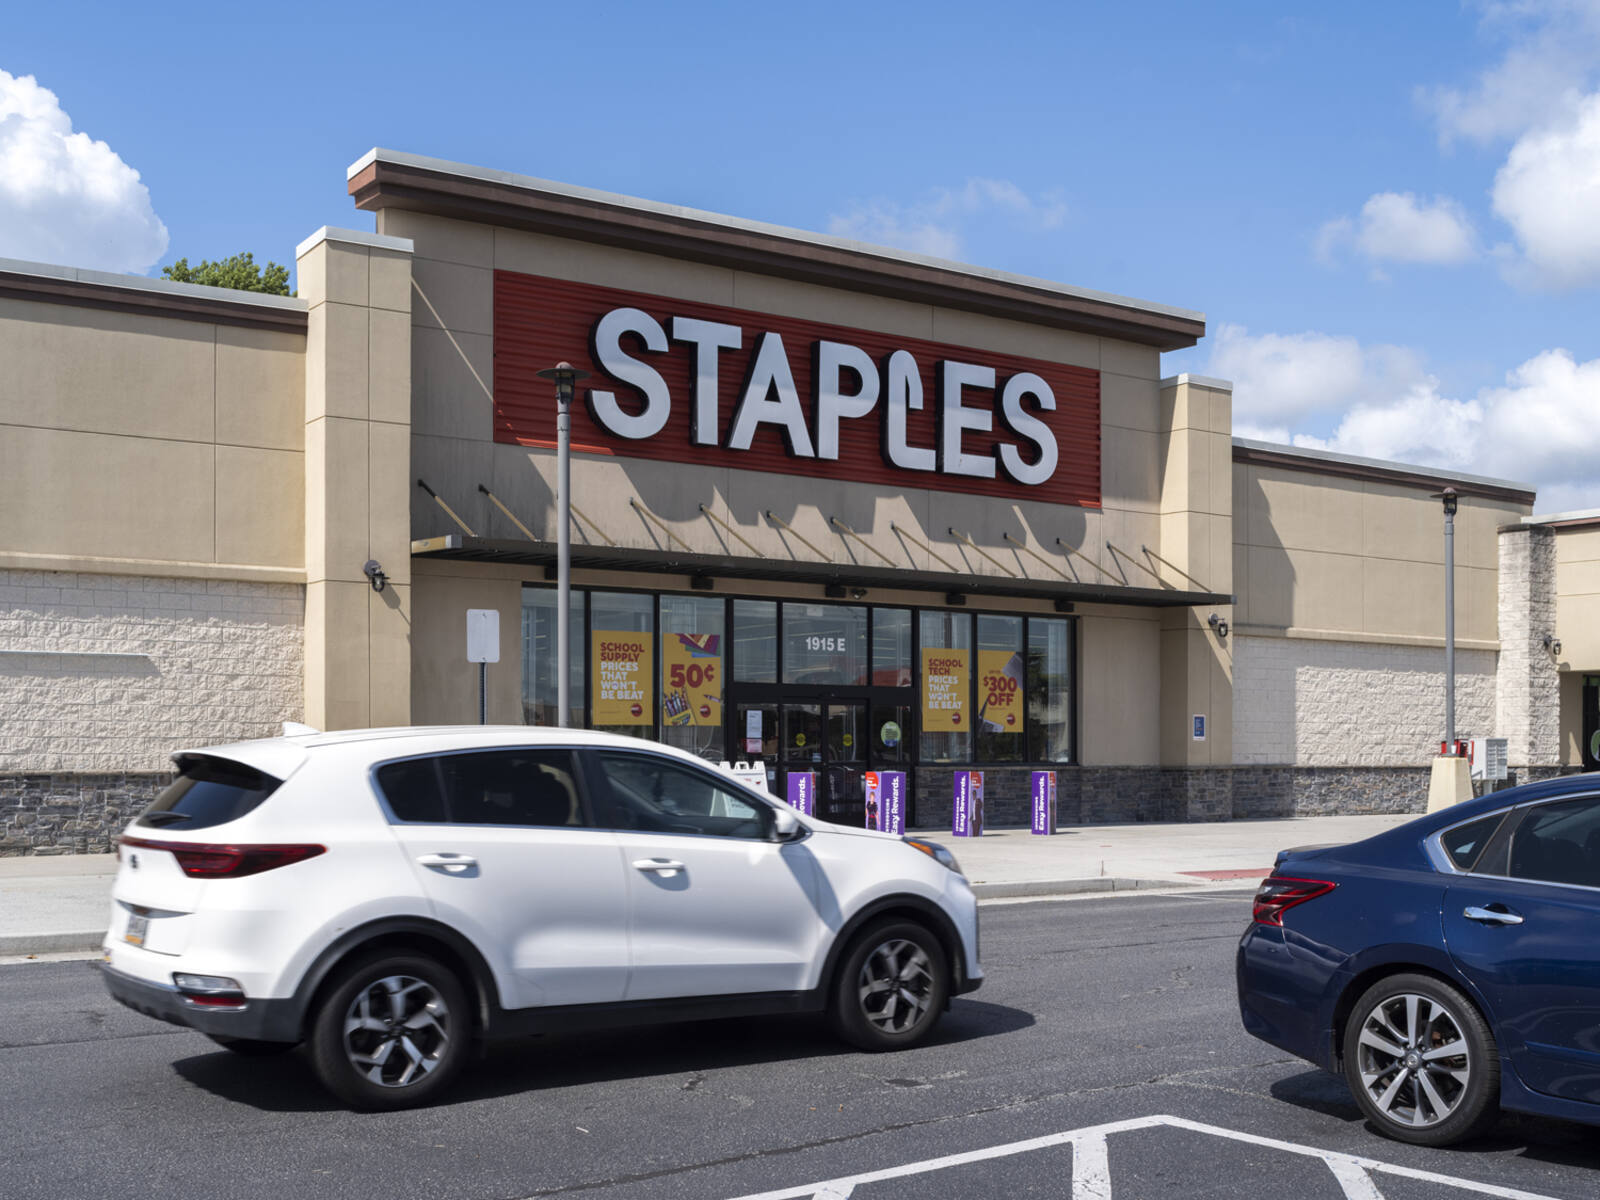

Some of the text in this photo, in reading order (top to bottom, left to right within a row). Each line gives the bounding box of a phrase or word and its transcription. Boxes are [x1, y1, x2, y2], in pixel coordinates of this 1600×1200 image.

[588, 307, 1059, 485] STAPLES
[600, 642, 645, 653] SCHOOL
[806, 636, 846, 652] 1915 E
[600, 652, 640, 662] SUPPLY
[600, 662, 639, 672] PRICES
[928, 658, 963, 668] SCHOOL
[600, 671, 628, 681] THAT
[670, 663, 715, 688] 50¢
[928, 667, 950, 676] TECH
[928, 675, 959, 684] PRICES
[983, 676, 1018, 693] $300
[600, 681, 637, 690] WON'T
[928, 684, 949, 693] THAT
[601, 690, 644, 700] BE BEAT
[928, 692, 957, 701] WON'T
[988, 692, 1015, 706] OFF
[928, 701, 962, 710] BE BEAT
[891, 814, 900, 834] Easy
